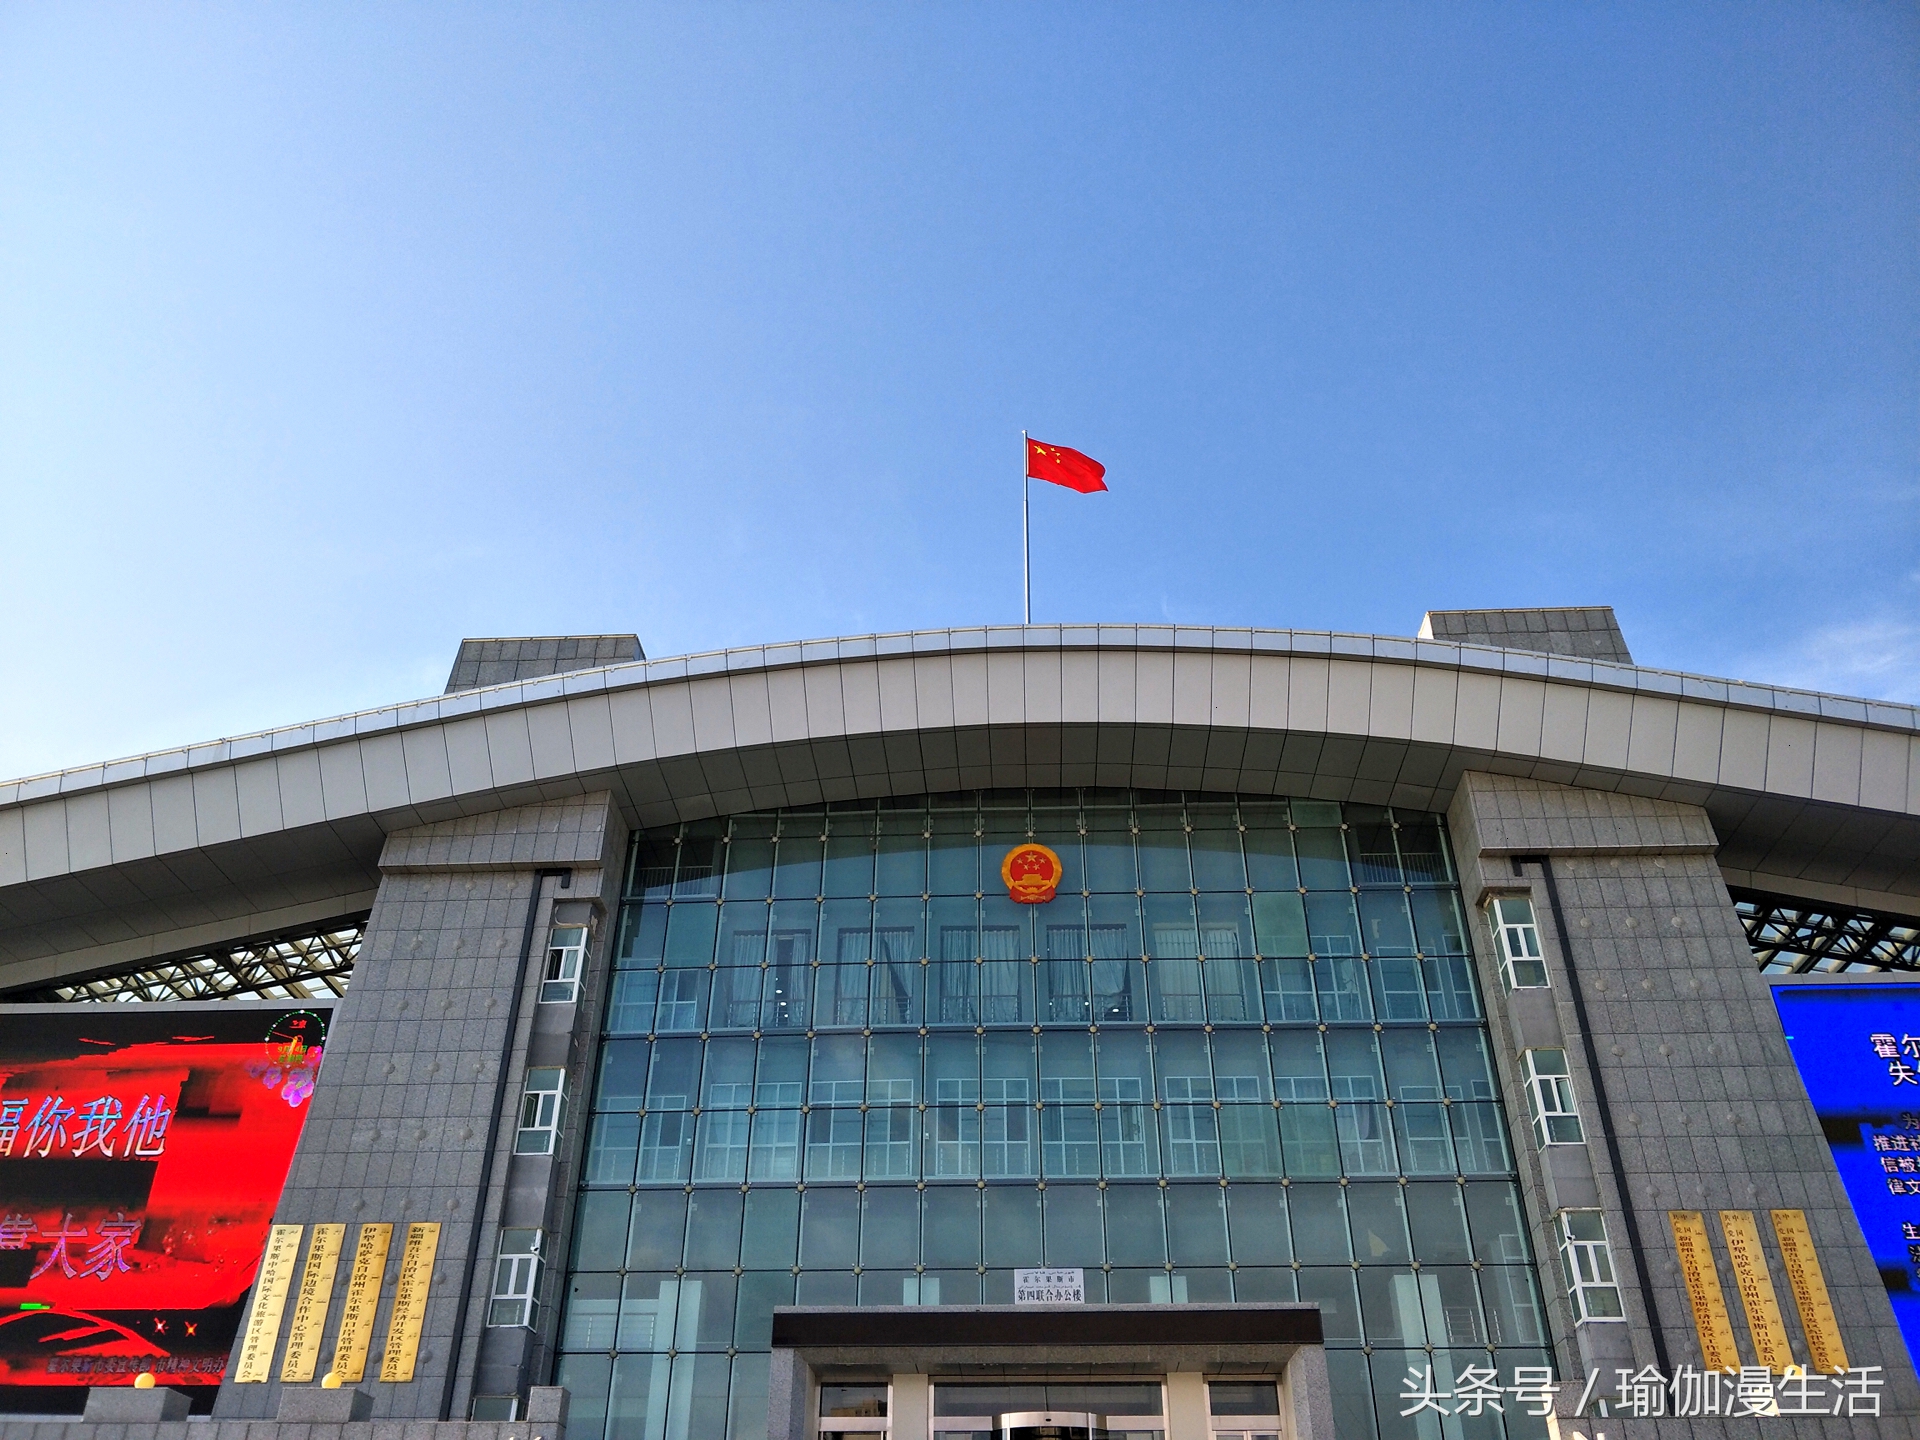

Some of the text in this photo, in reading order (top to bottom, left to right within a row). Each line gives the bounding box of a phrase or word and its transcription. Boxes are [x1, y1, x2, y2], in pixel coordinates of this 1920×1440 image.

[1023, 1275, 1075, 1284] 霍尔果斯市
[1018, 1289, 1082, 1302] 第四联合办公楼
[284, 1227, 329, 1379] 霍尔果斯国际边境合作中心管理委员会
